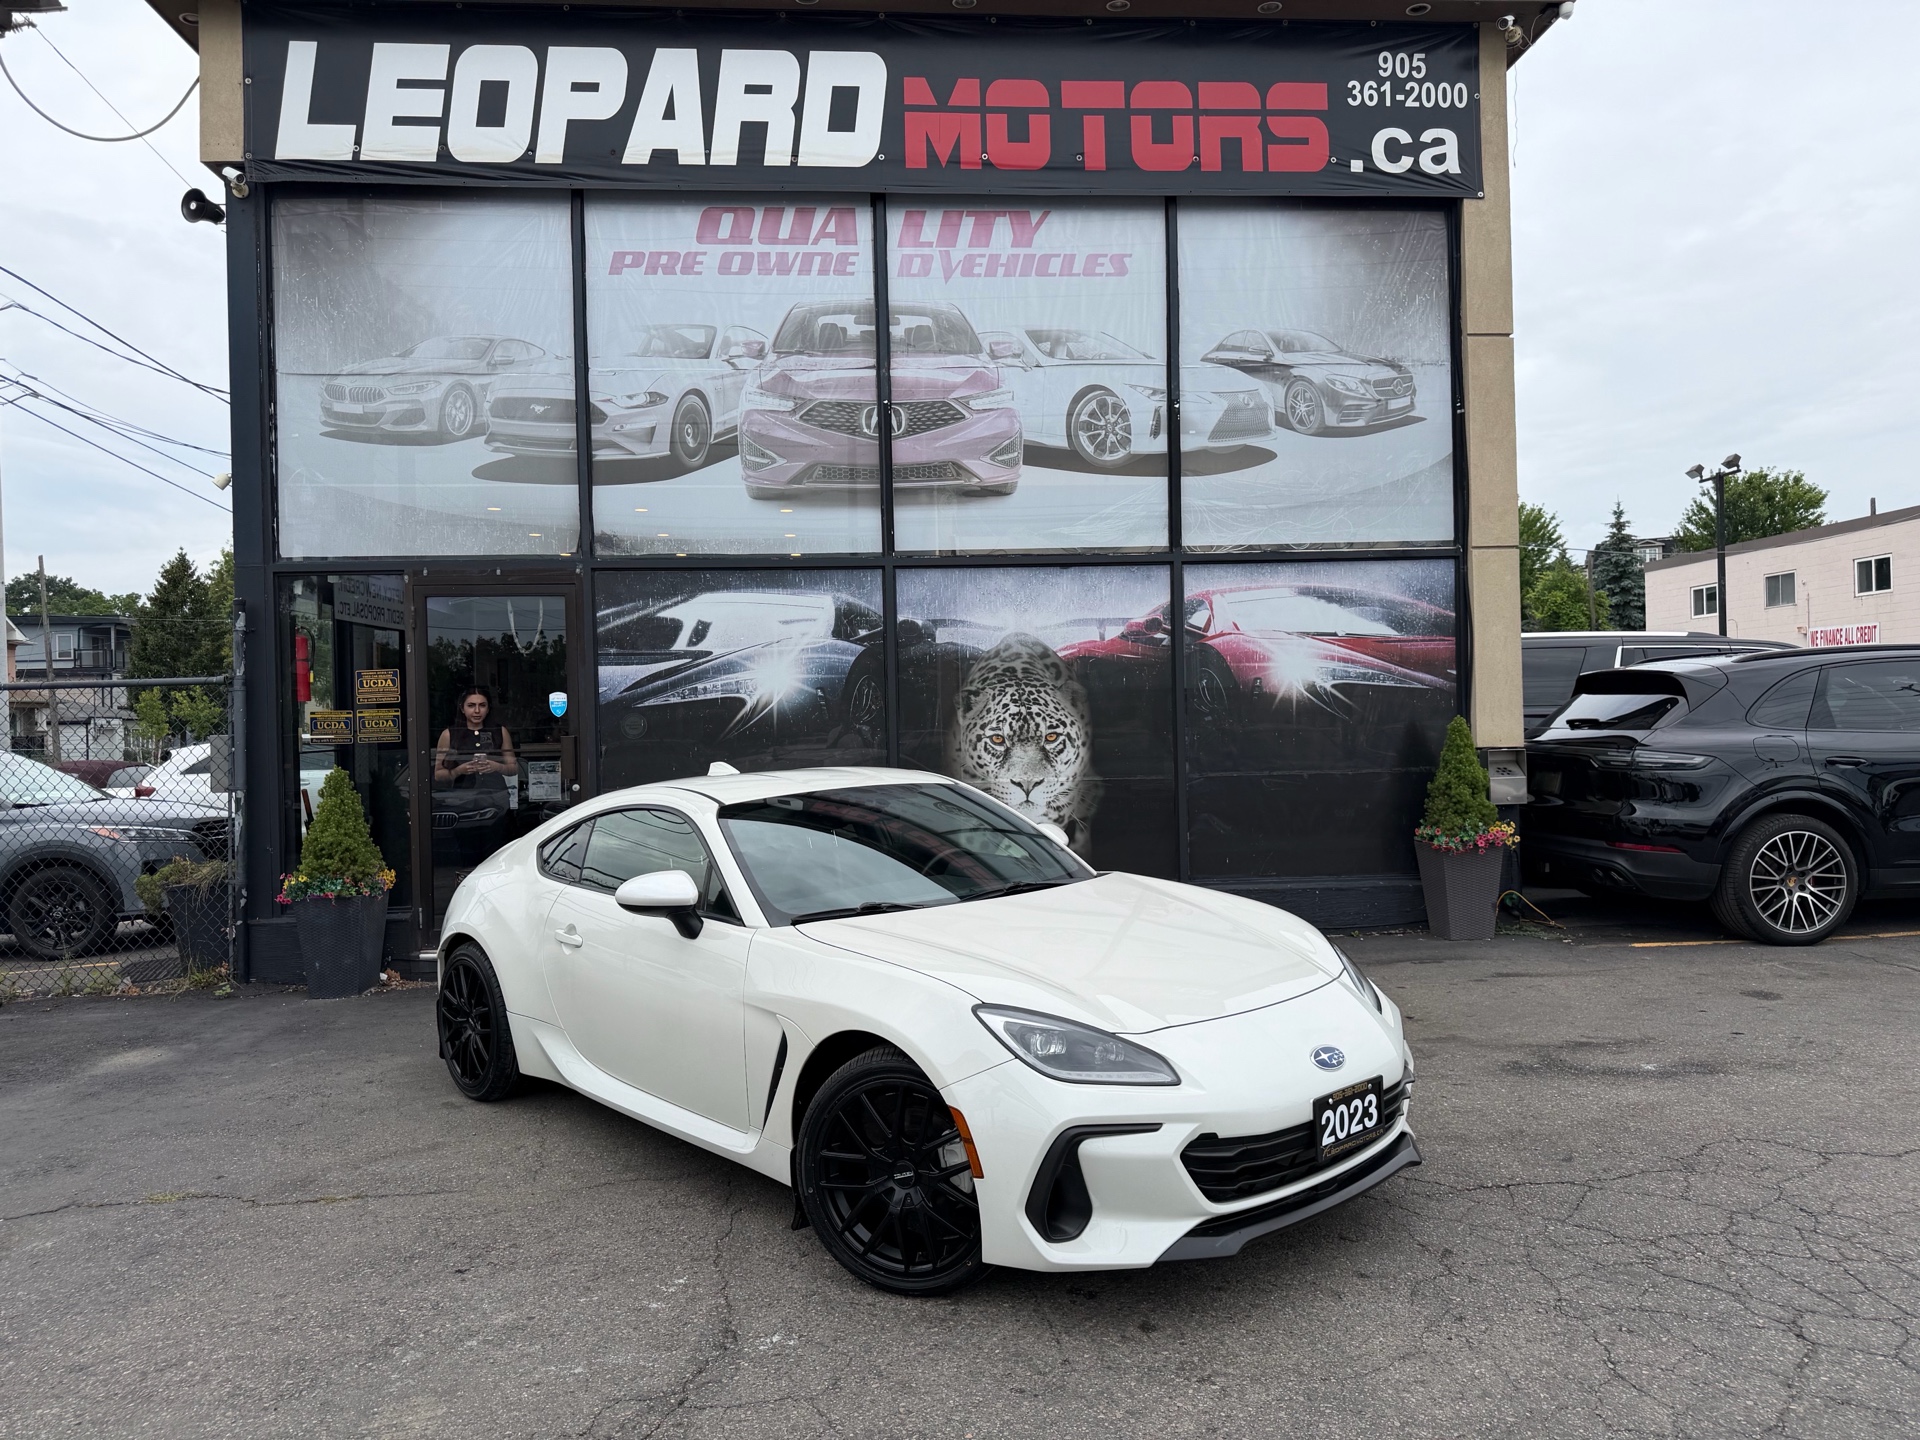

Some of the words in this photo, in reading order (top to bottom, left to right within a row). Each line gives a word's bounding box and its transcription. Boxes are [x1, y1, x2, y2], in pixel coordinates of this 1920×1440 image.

[1378, 52, 1427, 79] 905
[274, 40, 888, 168] LEOPARD
[903, 77, 1330, 172] MOTORS
[1347, 81, 1468, 109] 361-2000
[1350, 127, 1462, 175] .ca
[608, 251, 707, 276] PRE
[1810, 630, 1818, 647] WE
[1820, 628, 1843, 646] FINANCE
[1844, 627, 1854, 645] ALL
[1856, 625, 1878, 644] CREDIT
[363, 679, 394, 688] UCDA
[316, 721, 346, 729] UCDA
[364, 720, 394, 728] UCDA
[1321, 1093, 1378, 1147] 2023
